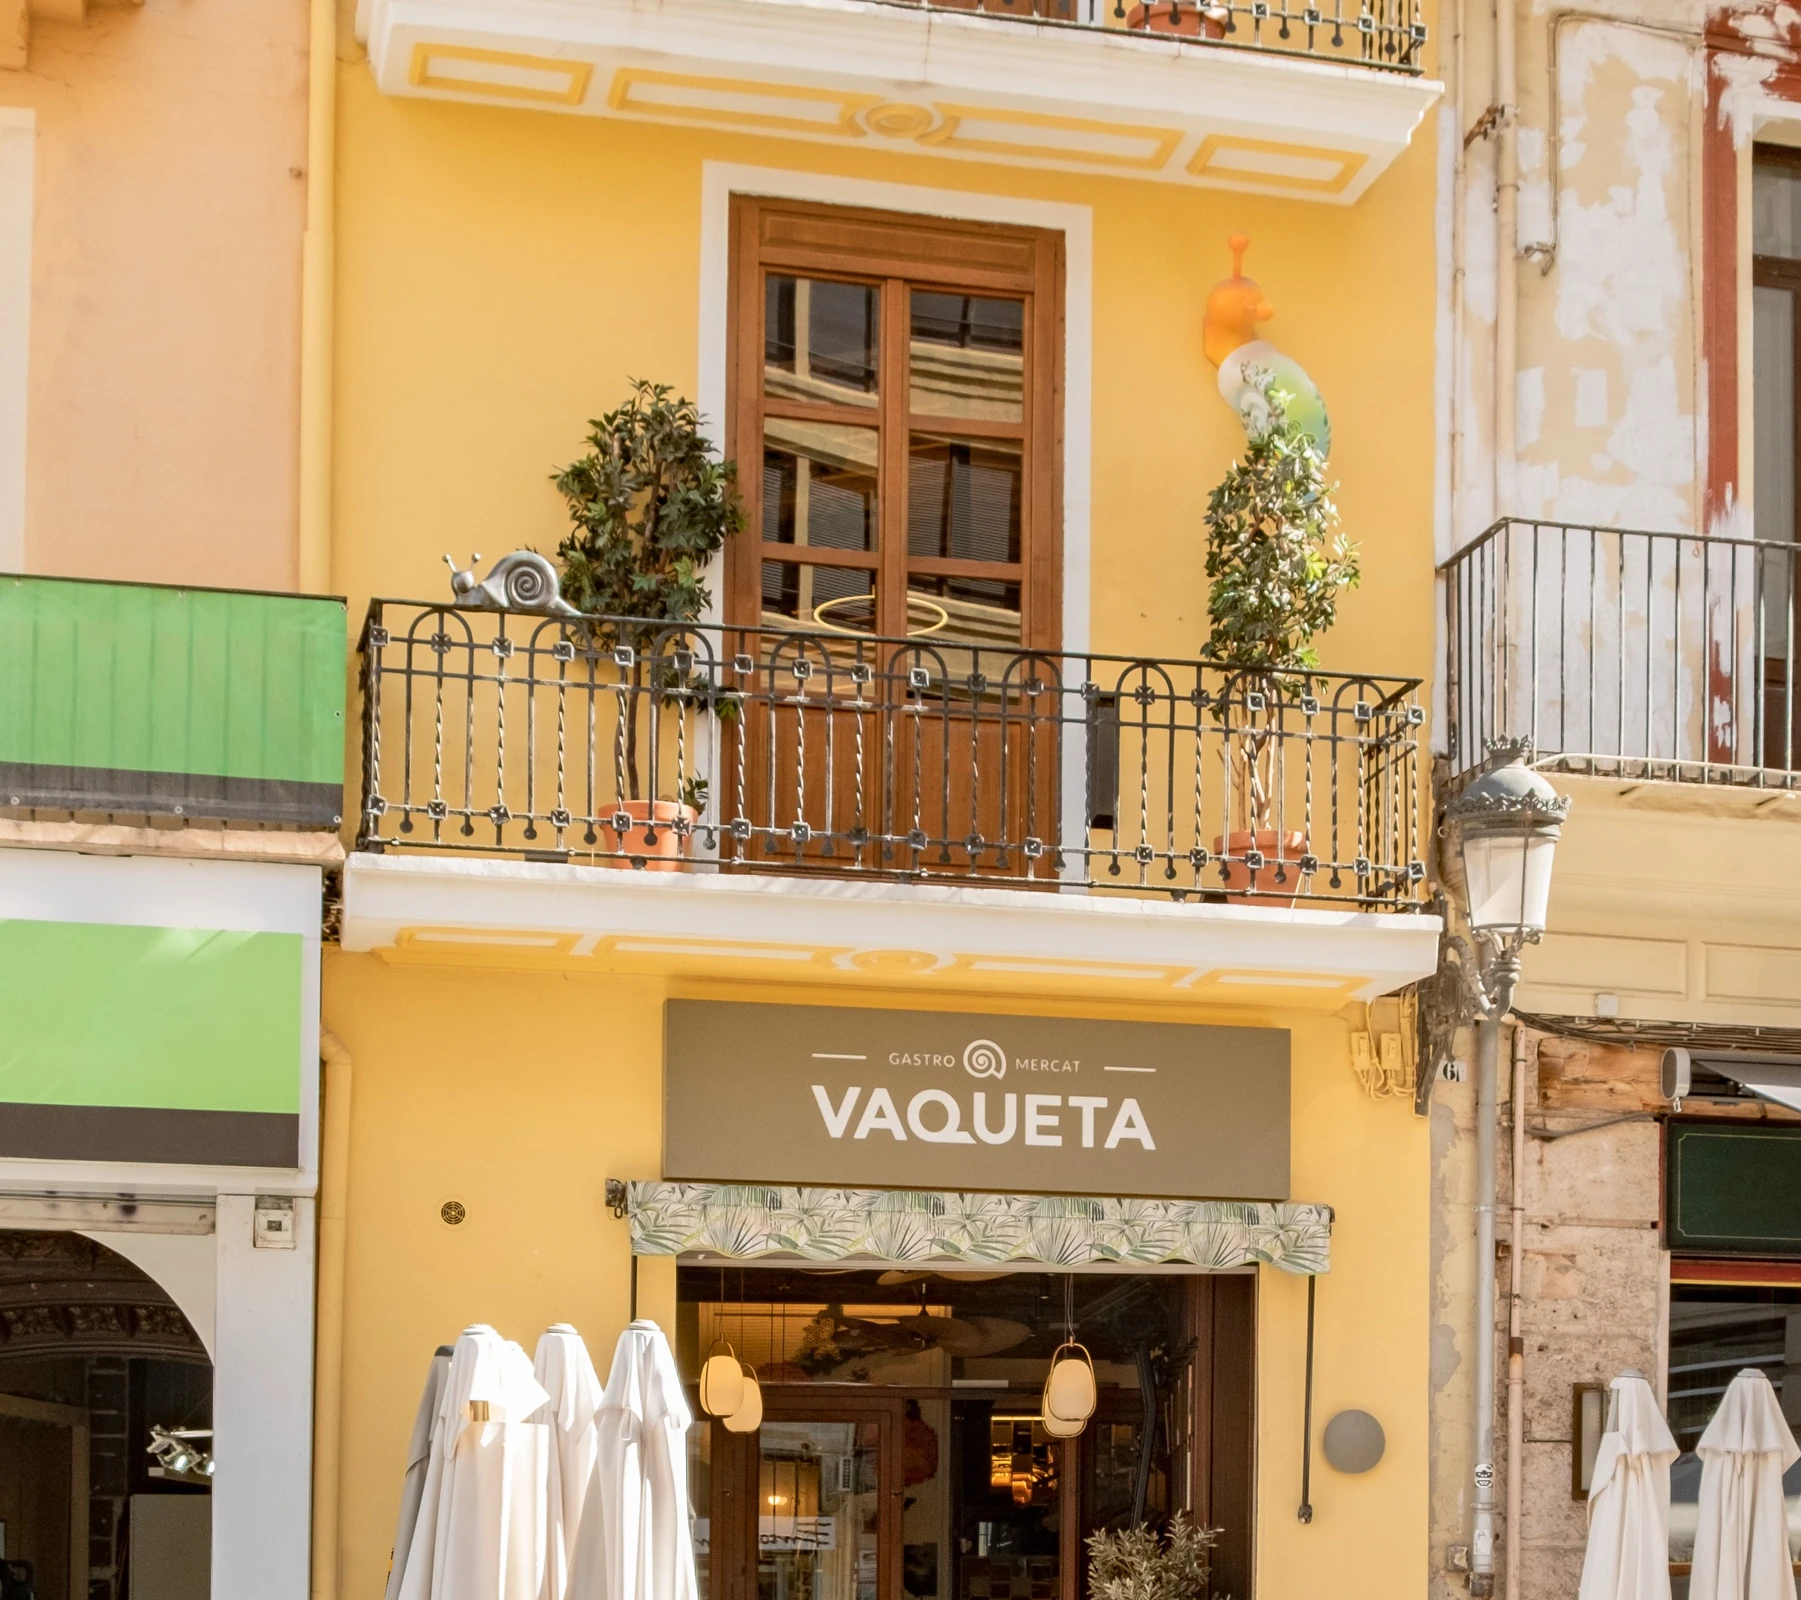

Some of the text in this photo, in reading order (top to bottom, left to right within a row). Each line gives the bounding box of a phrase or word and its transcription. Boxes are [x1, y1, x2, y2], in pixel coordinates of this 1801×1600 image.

[889, 1052, 1081, 1073] GASTRO MERCAT
[811, 1085, 1156, 1150] VAQUETA
